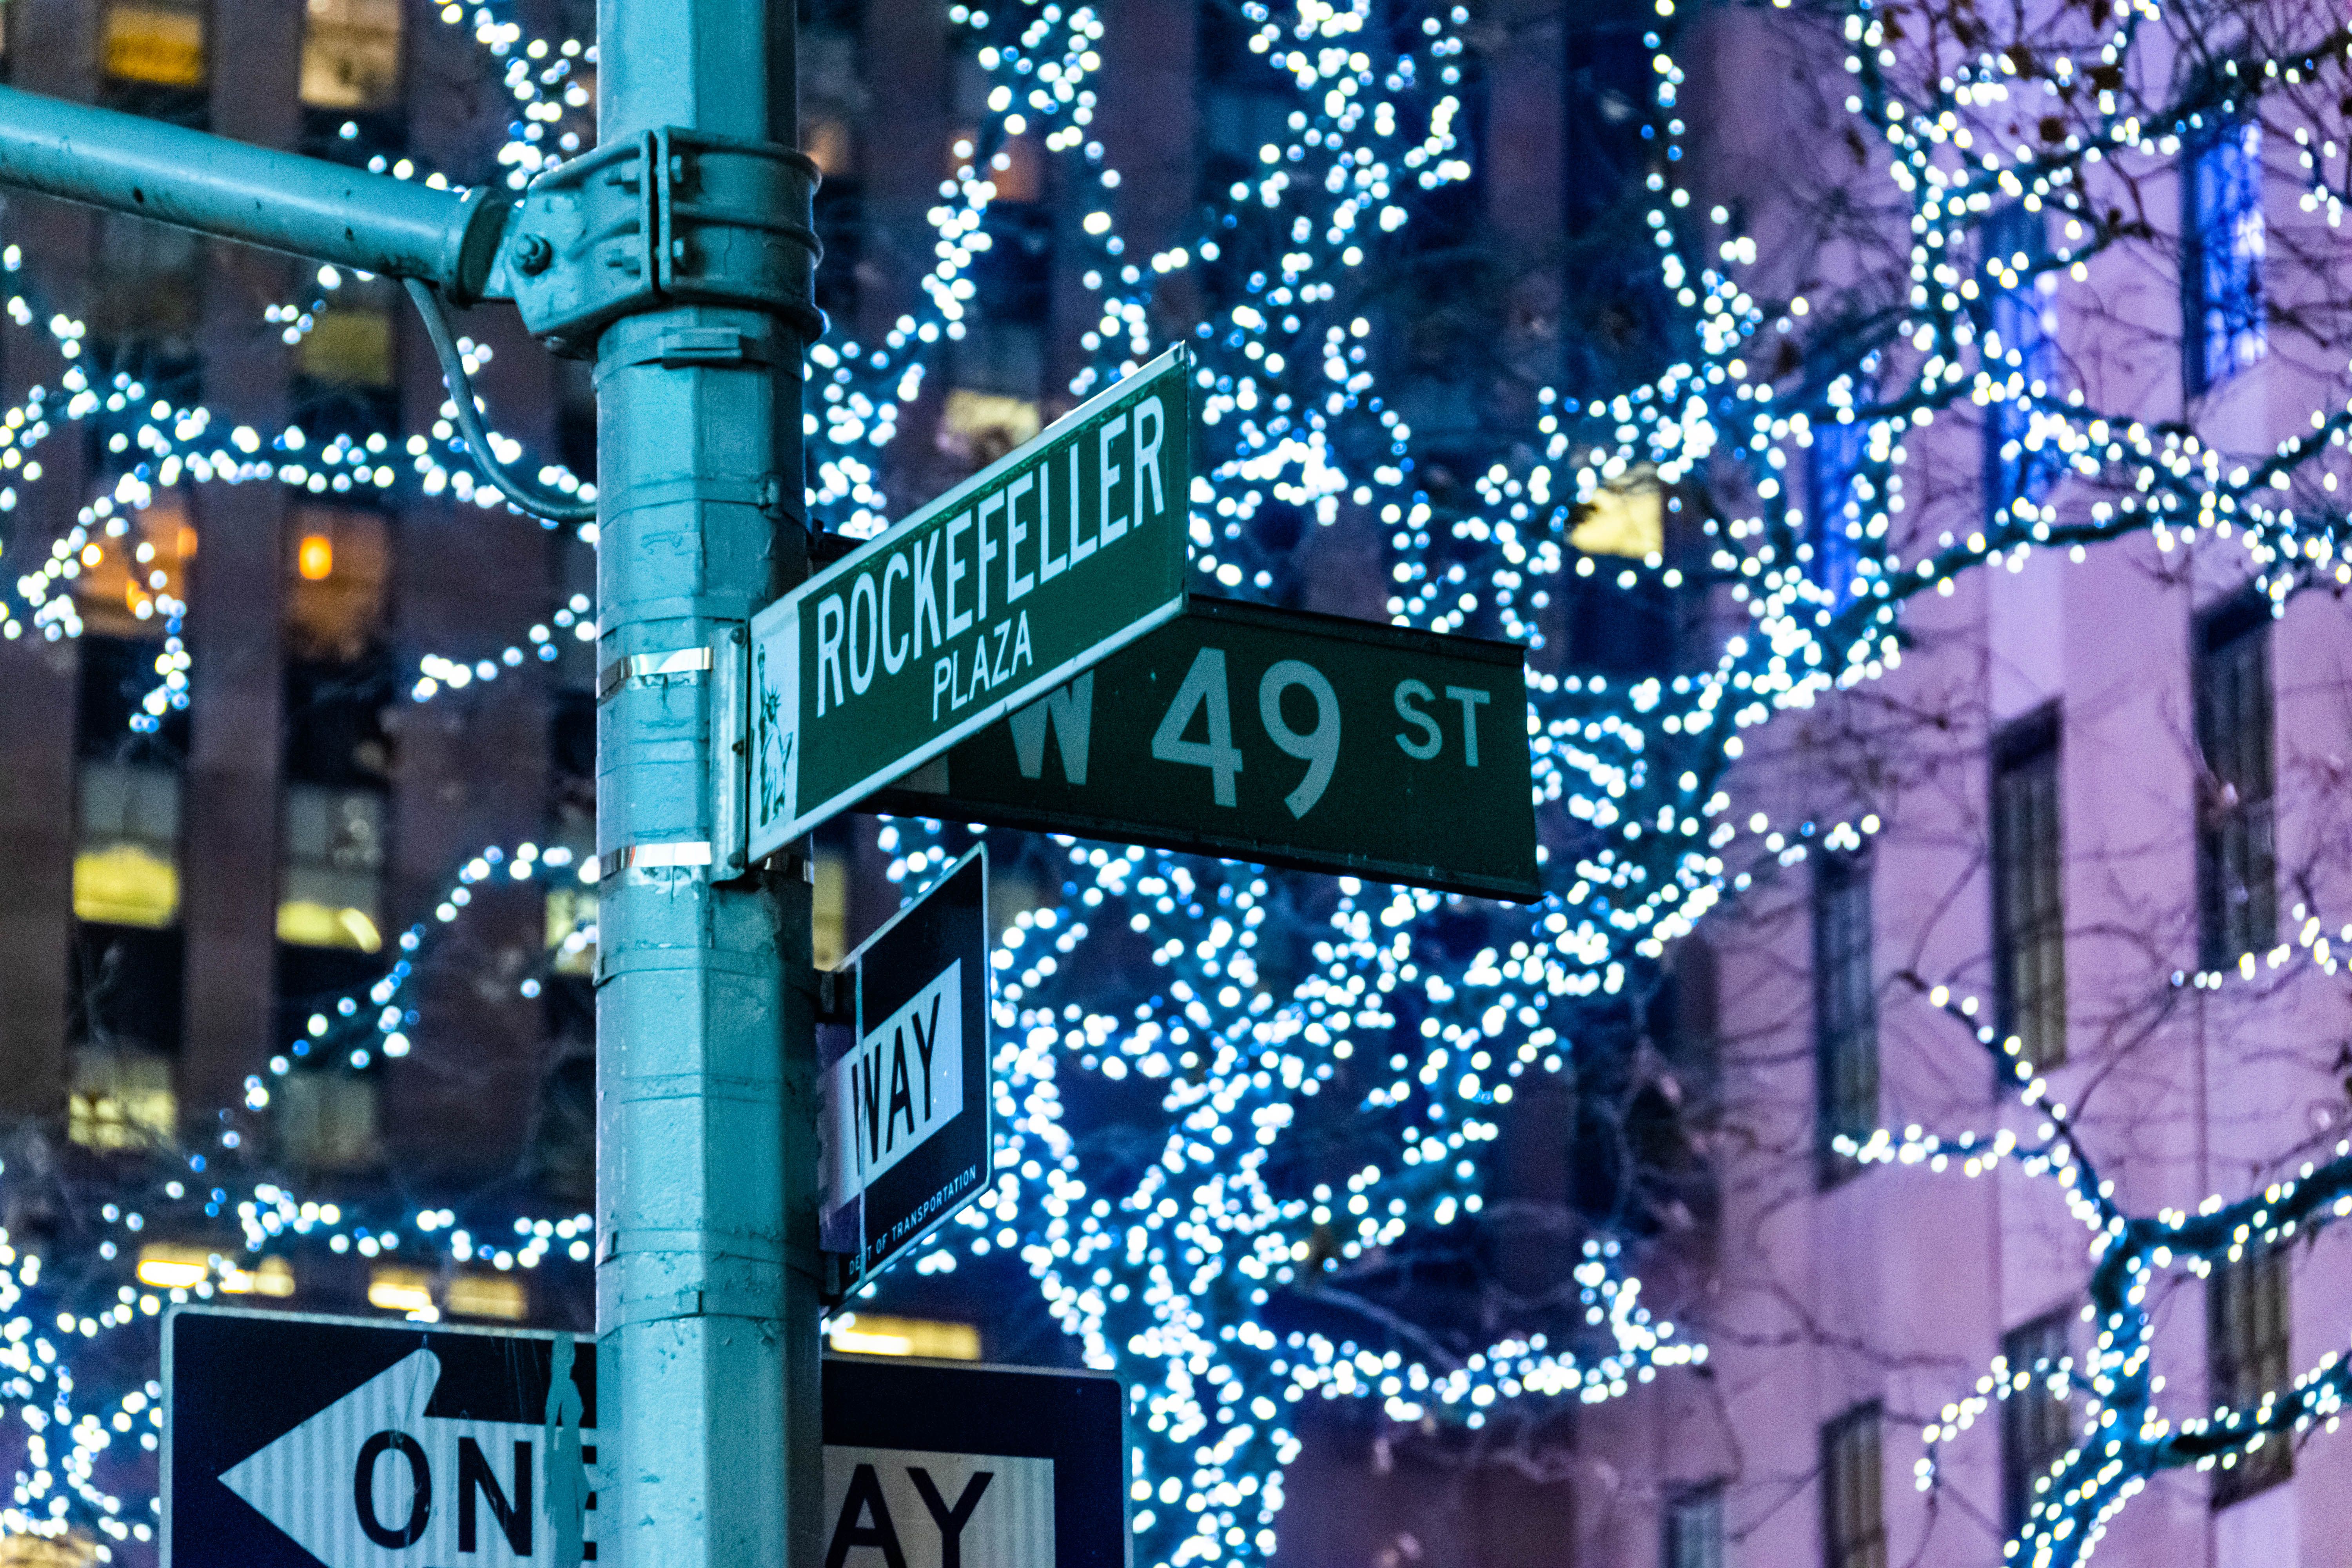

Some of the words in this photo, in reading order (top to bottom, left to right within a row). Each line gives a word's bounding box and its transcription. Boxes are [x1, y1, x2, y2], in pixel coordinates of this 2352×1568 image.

[817, 396, 1164, 718] ROCKEFELLER
[933, 610, 1033, 722] PLAZA
[1009, 669, 1094, 785] W
[1151, 646, 1341, 820] 49
[1394, 679, 1491, 767] ST
[851, 991, 941, 1176] WAY
[849, 1245, 872, 1275] DET
[876, 1232, 887, 1254] OF
[891, 1163, 976, 1241] TRANSPORTATION
[824, 1463, 995, 1568] AY
